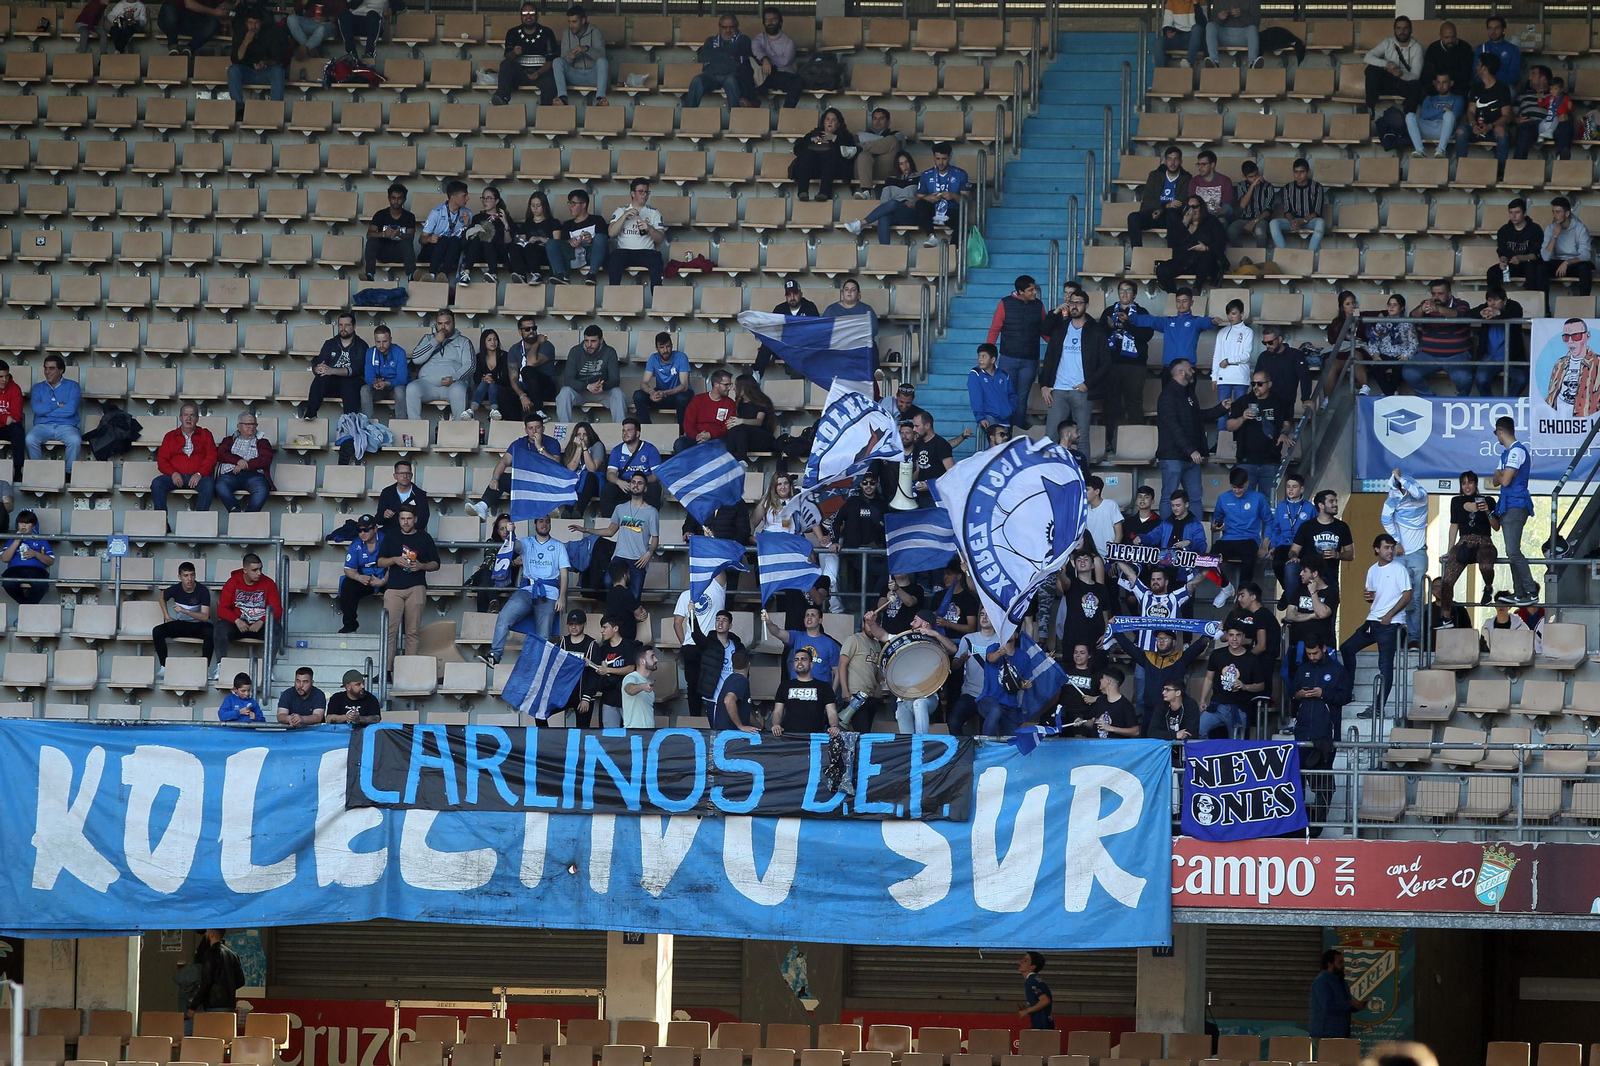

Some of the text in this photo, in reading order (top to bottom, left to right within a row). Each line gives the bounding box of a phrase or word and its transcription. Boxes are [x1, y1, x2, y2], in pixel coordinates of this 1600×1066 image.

[1539, 419, 1587, 434] CHOOSE
[1313, 533, 1340, 543] ULTRAS
[1173, 550, 1197, 568] SUR
[788, 688, 817, 698] KS91
[359, 721, 765, 814] CARLIÑOS
[1188, 743, 1295, 789] NEW
[1191, 781, 1297, 826] ONES
[883, 764, 1147, 913] SUR
[1335, 856, 1356, 896] SIN
[1386, 864, 1410, 876] con
[1396, 868, 1476, 900] Xerez CD
[1478, 871, 1510, 894] XEREZ
[1353, 952, 1394, 998] EREZ
